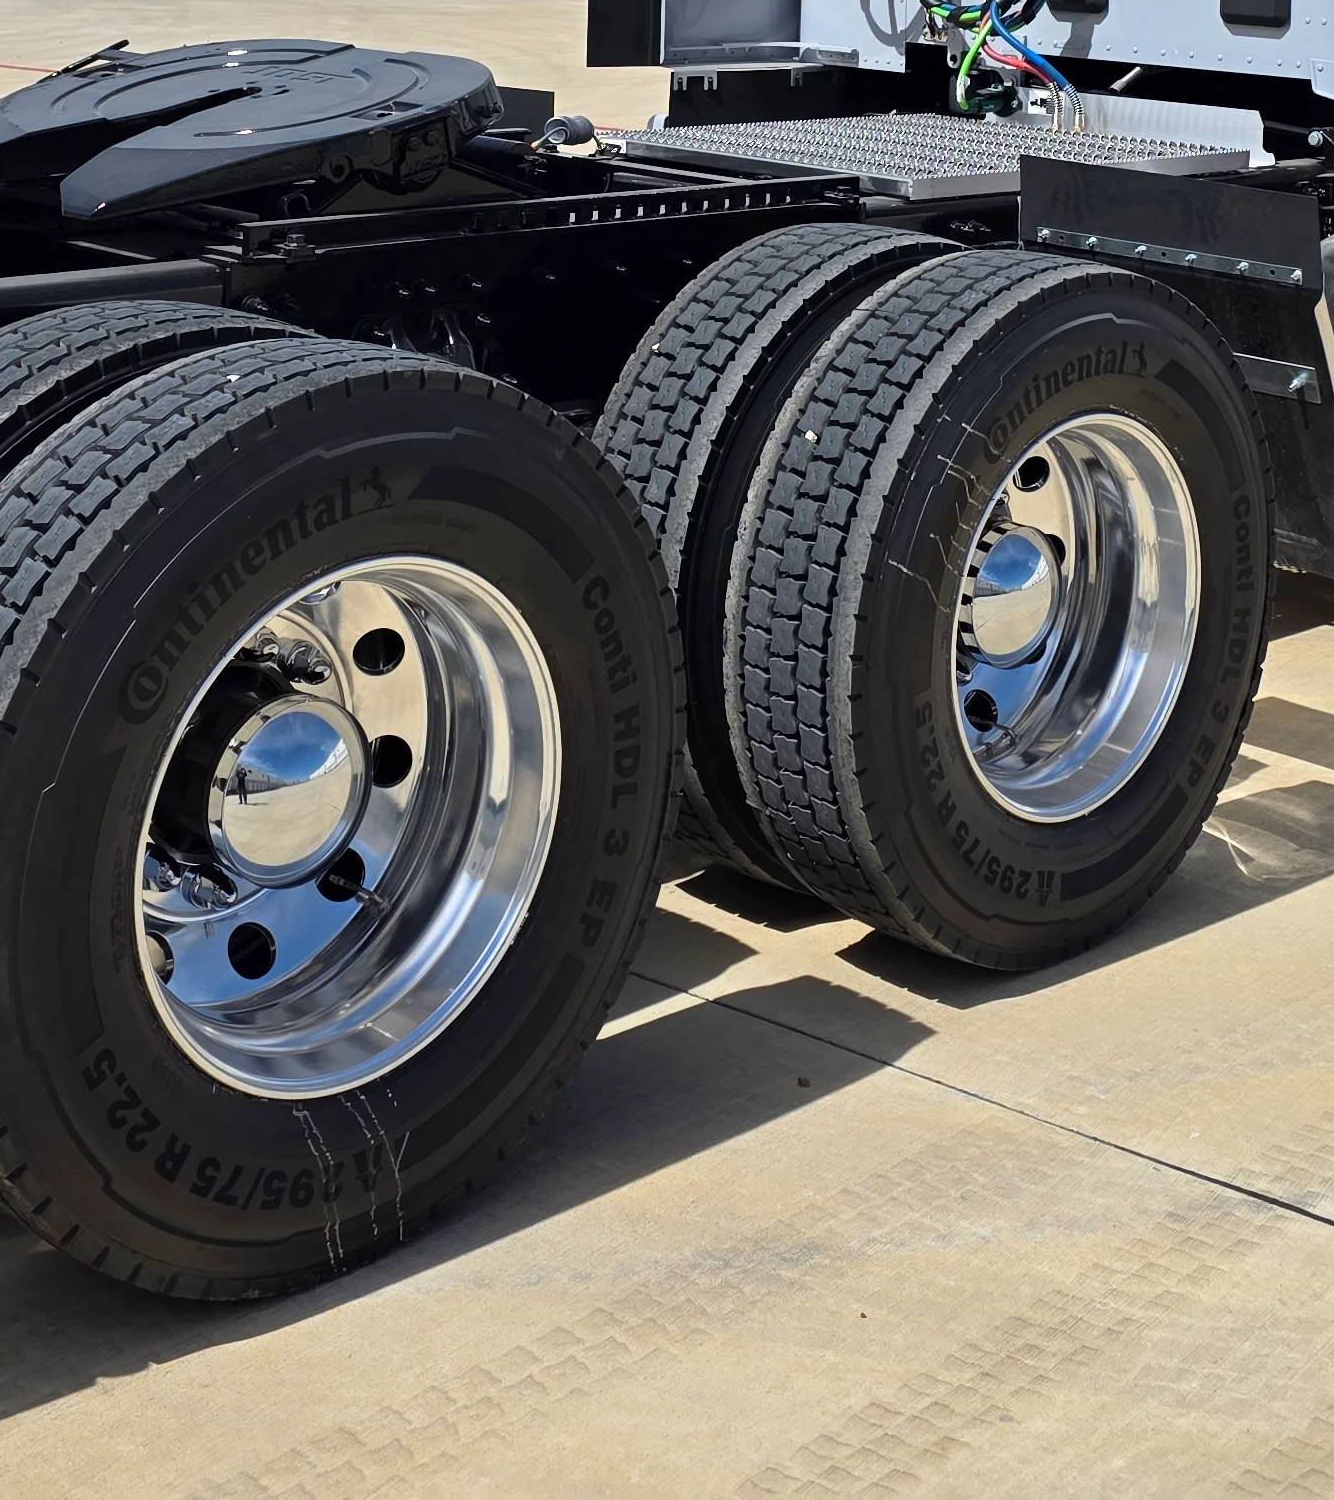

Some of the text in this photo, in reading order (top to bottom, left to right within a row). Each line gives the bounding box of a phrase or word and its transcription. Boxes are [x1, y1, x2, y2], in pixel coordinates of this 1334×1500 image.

[983, 340, 1128, 464] Continental
[118, 476, 354, 725] Continental
[1184, 494, 1254, 791] Conti HDL 3 EP
[578, 575, 642, 949] Conti HDL 3 EP
[915, 700, 1033, 900] 295/75 R 22.5
[81, 1047, 162, 1154] 22.5
[154, 1133, 193, 1184] R
[189, 1156, 345, 1210] 295/75
